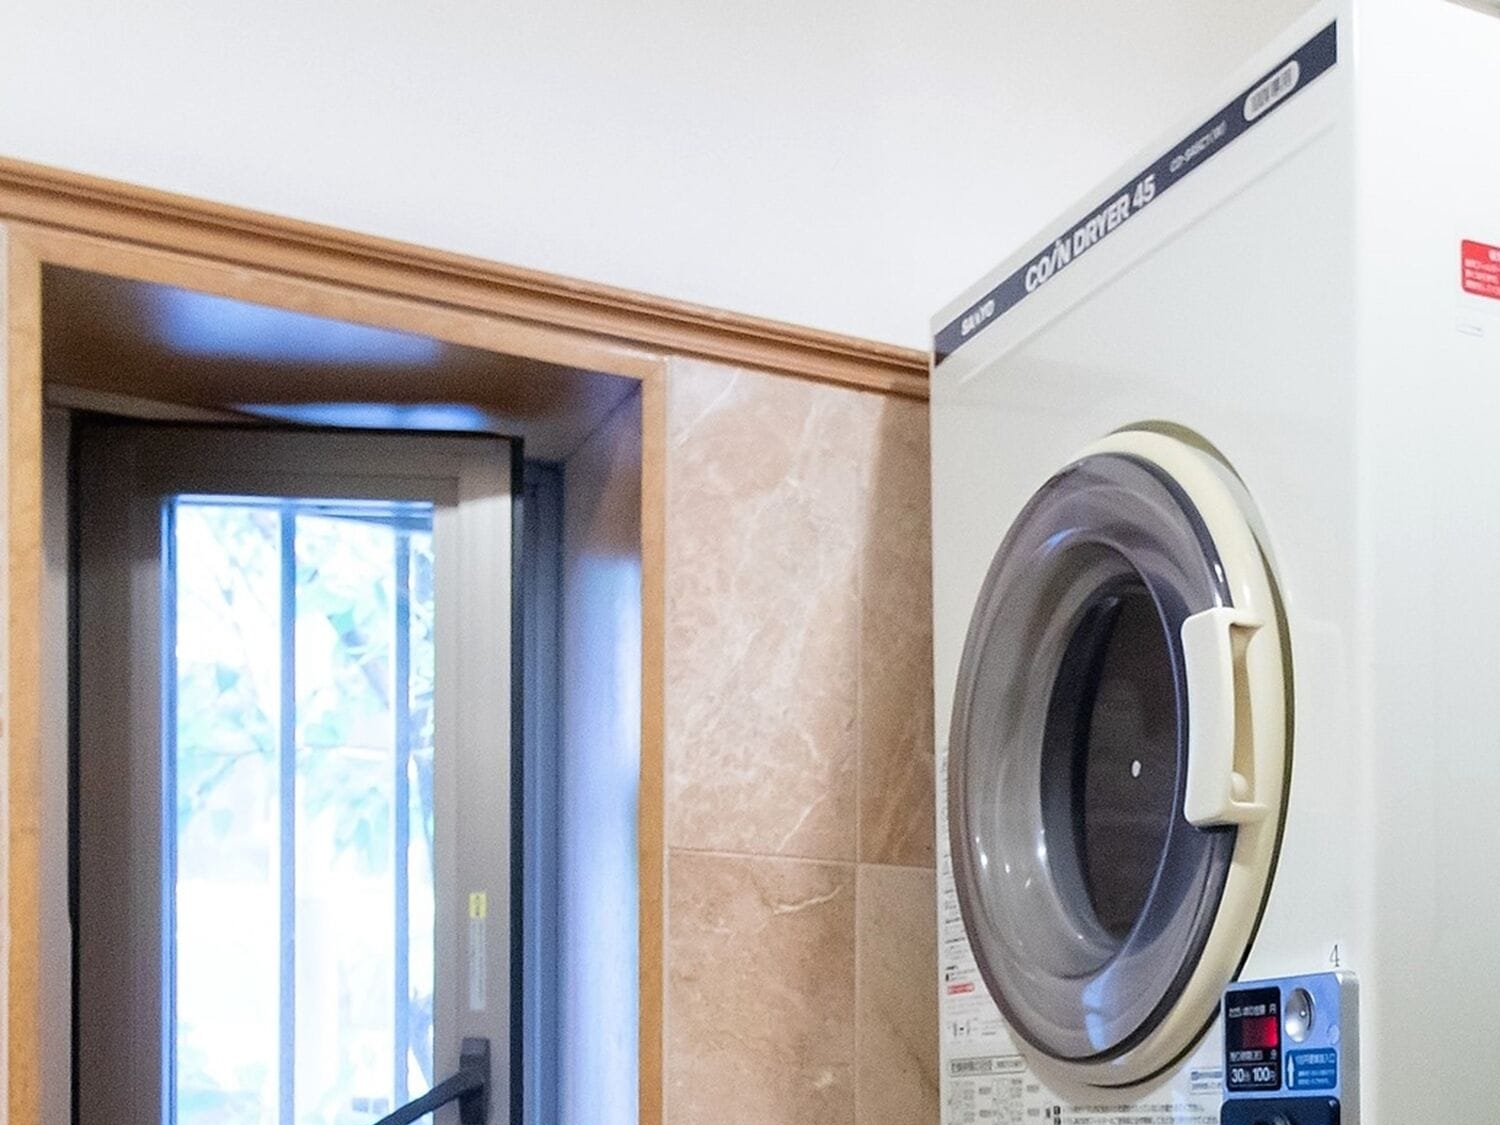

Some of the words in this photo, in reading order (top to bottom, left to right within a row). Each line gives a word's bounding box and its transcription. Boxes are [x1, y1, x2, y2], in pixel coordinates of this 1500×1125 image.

[1072, 193, 1130, 257] DRYER
[1132, 174, 1157, 208] 45
[1330, 944, 1340, 967] 4
